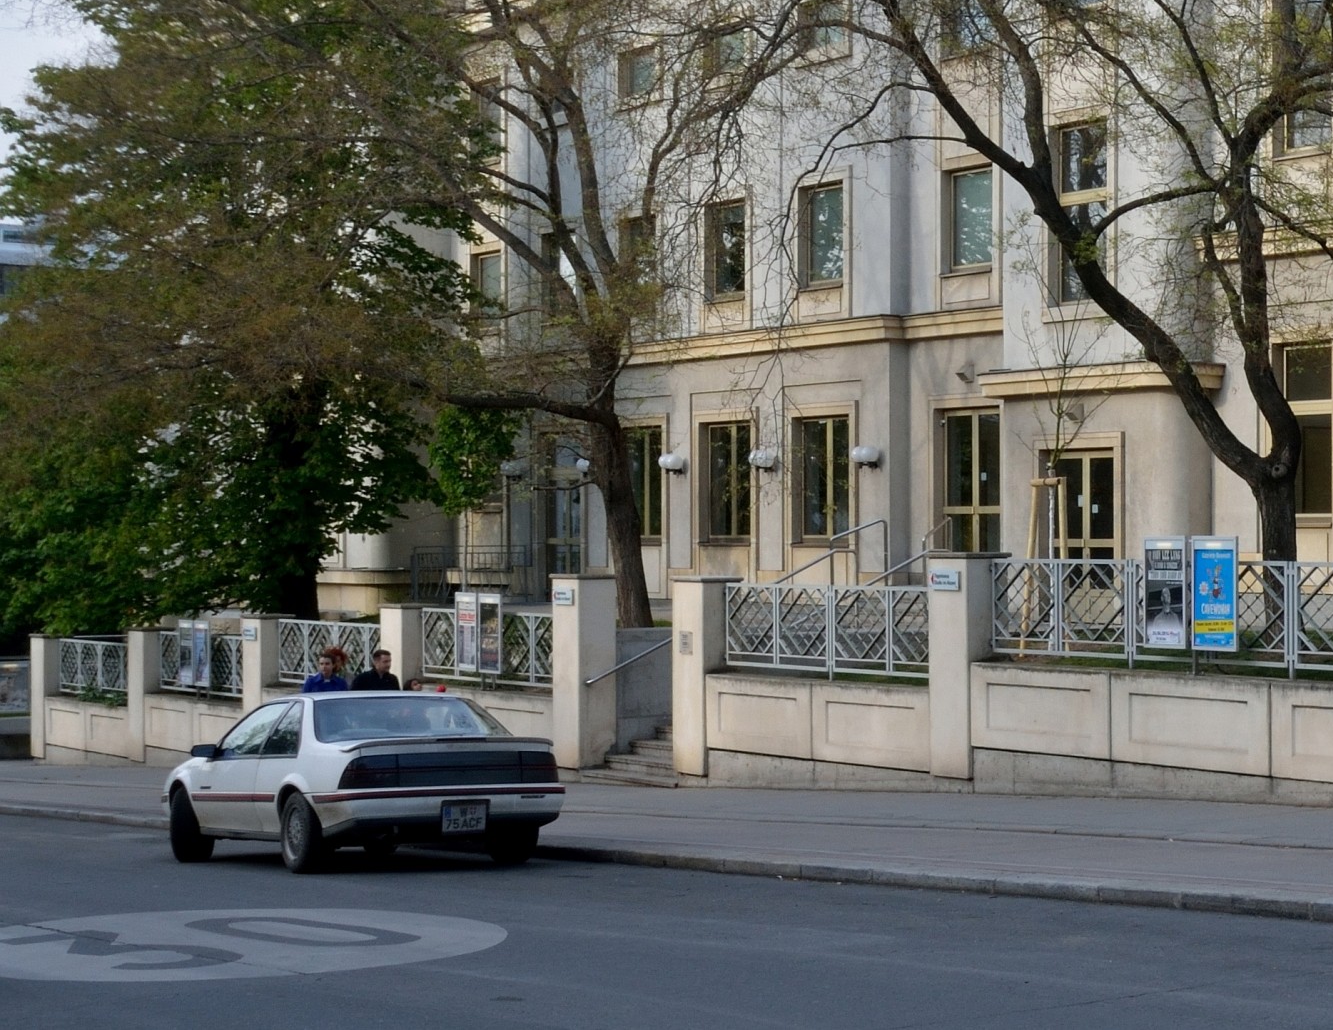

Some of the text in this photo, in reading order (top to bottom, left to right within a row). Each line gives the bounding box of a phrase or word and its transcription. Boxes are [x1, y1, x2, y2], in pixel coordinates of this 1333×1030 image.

[460, 807, 467, 818] W
[446, 817, 483, 830] 75 ACF
